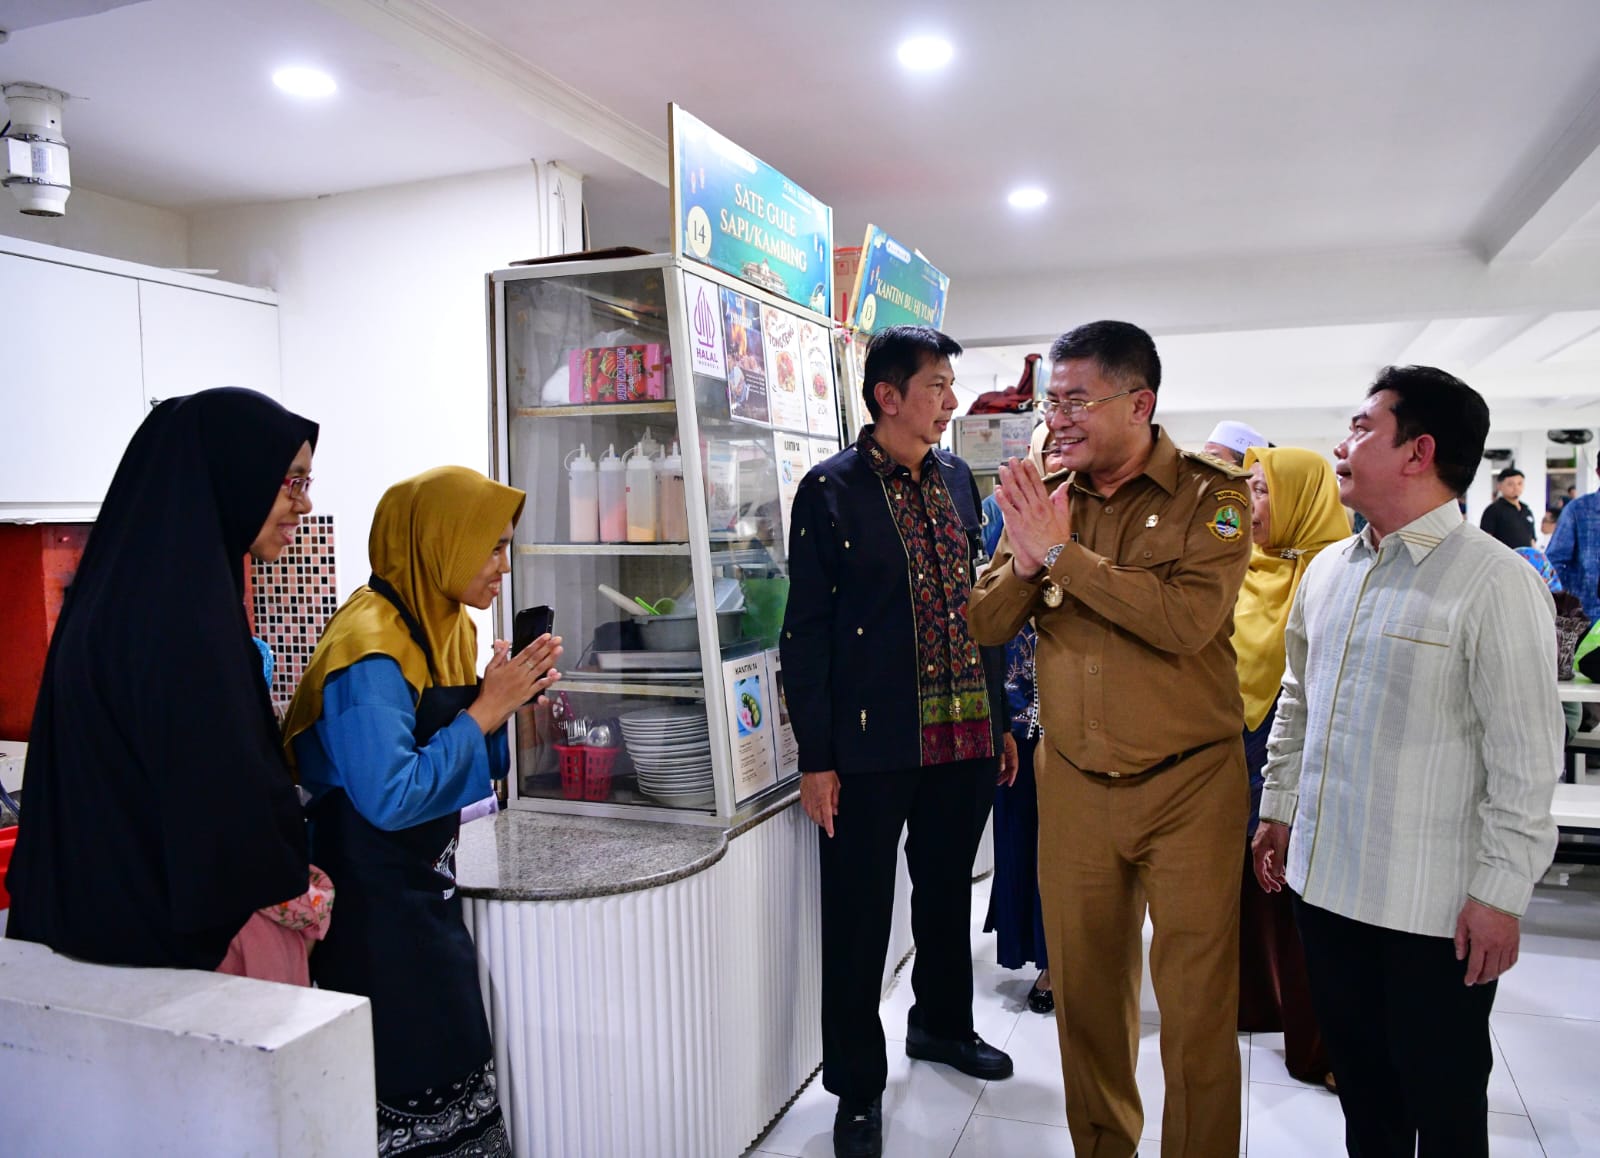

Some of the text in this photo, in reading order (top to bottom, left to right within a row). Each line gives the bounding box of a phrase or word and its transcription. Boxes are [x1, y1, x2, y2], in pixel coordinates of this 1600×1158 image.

[735, 183, 764, 219] SATE
[766, 202, 797, 238] GULE
[693, 219, 706, 245] 14
[720, 208, 807, 273] SAPI/KAMBING
[875, 279, 904, 305] KANTIN
[696, 347, 719, 363] HALAL
